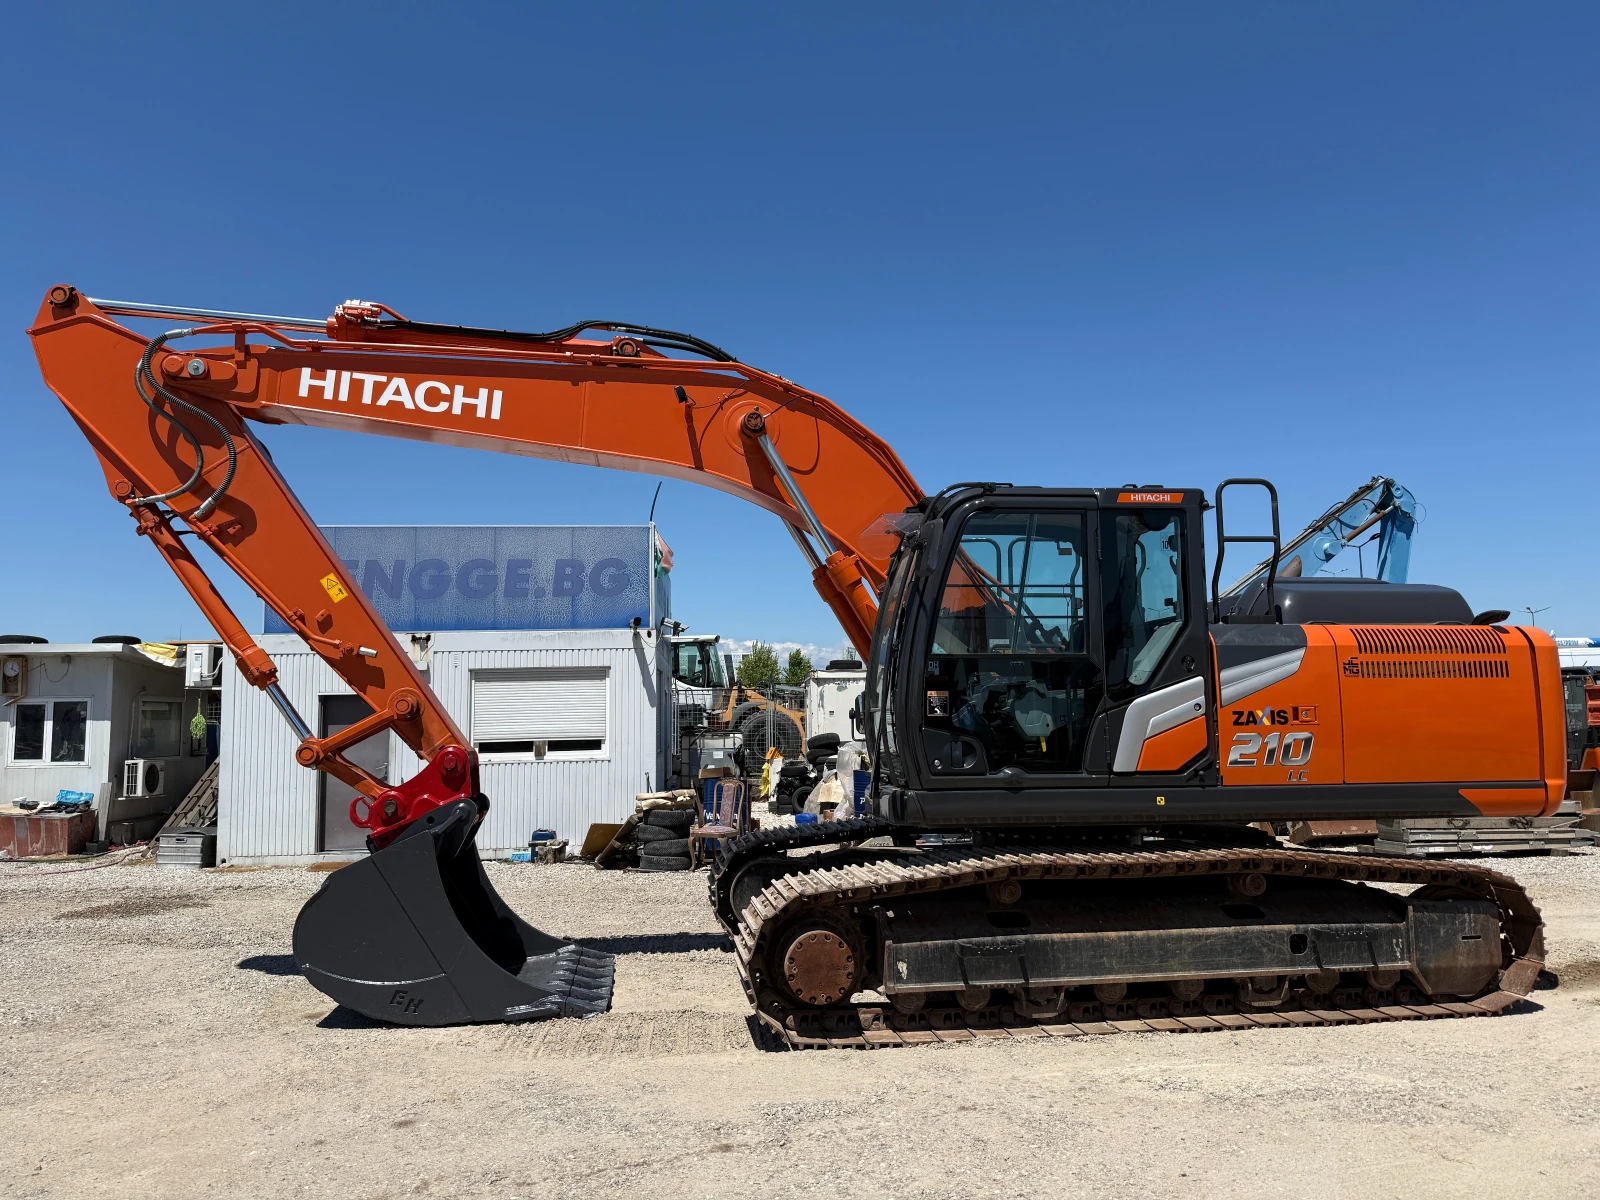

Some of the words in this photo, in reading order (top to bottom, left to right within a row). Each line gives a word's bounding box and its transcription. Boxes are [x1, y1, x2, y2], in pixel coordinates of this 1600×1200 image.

[298, 367, 503, 420] HITACHI
[1130, 493, 1171, 502] HITACHI
[342, 557, 630, 599] NGGE.BG
[1232, 706, 1289, 726] ZAXIS
[1226, 732, 1315, 767] 210
[1286, 769, 1310, 782] LC
